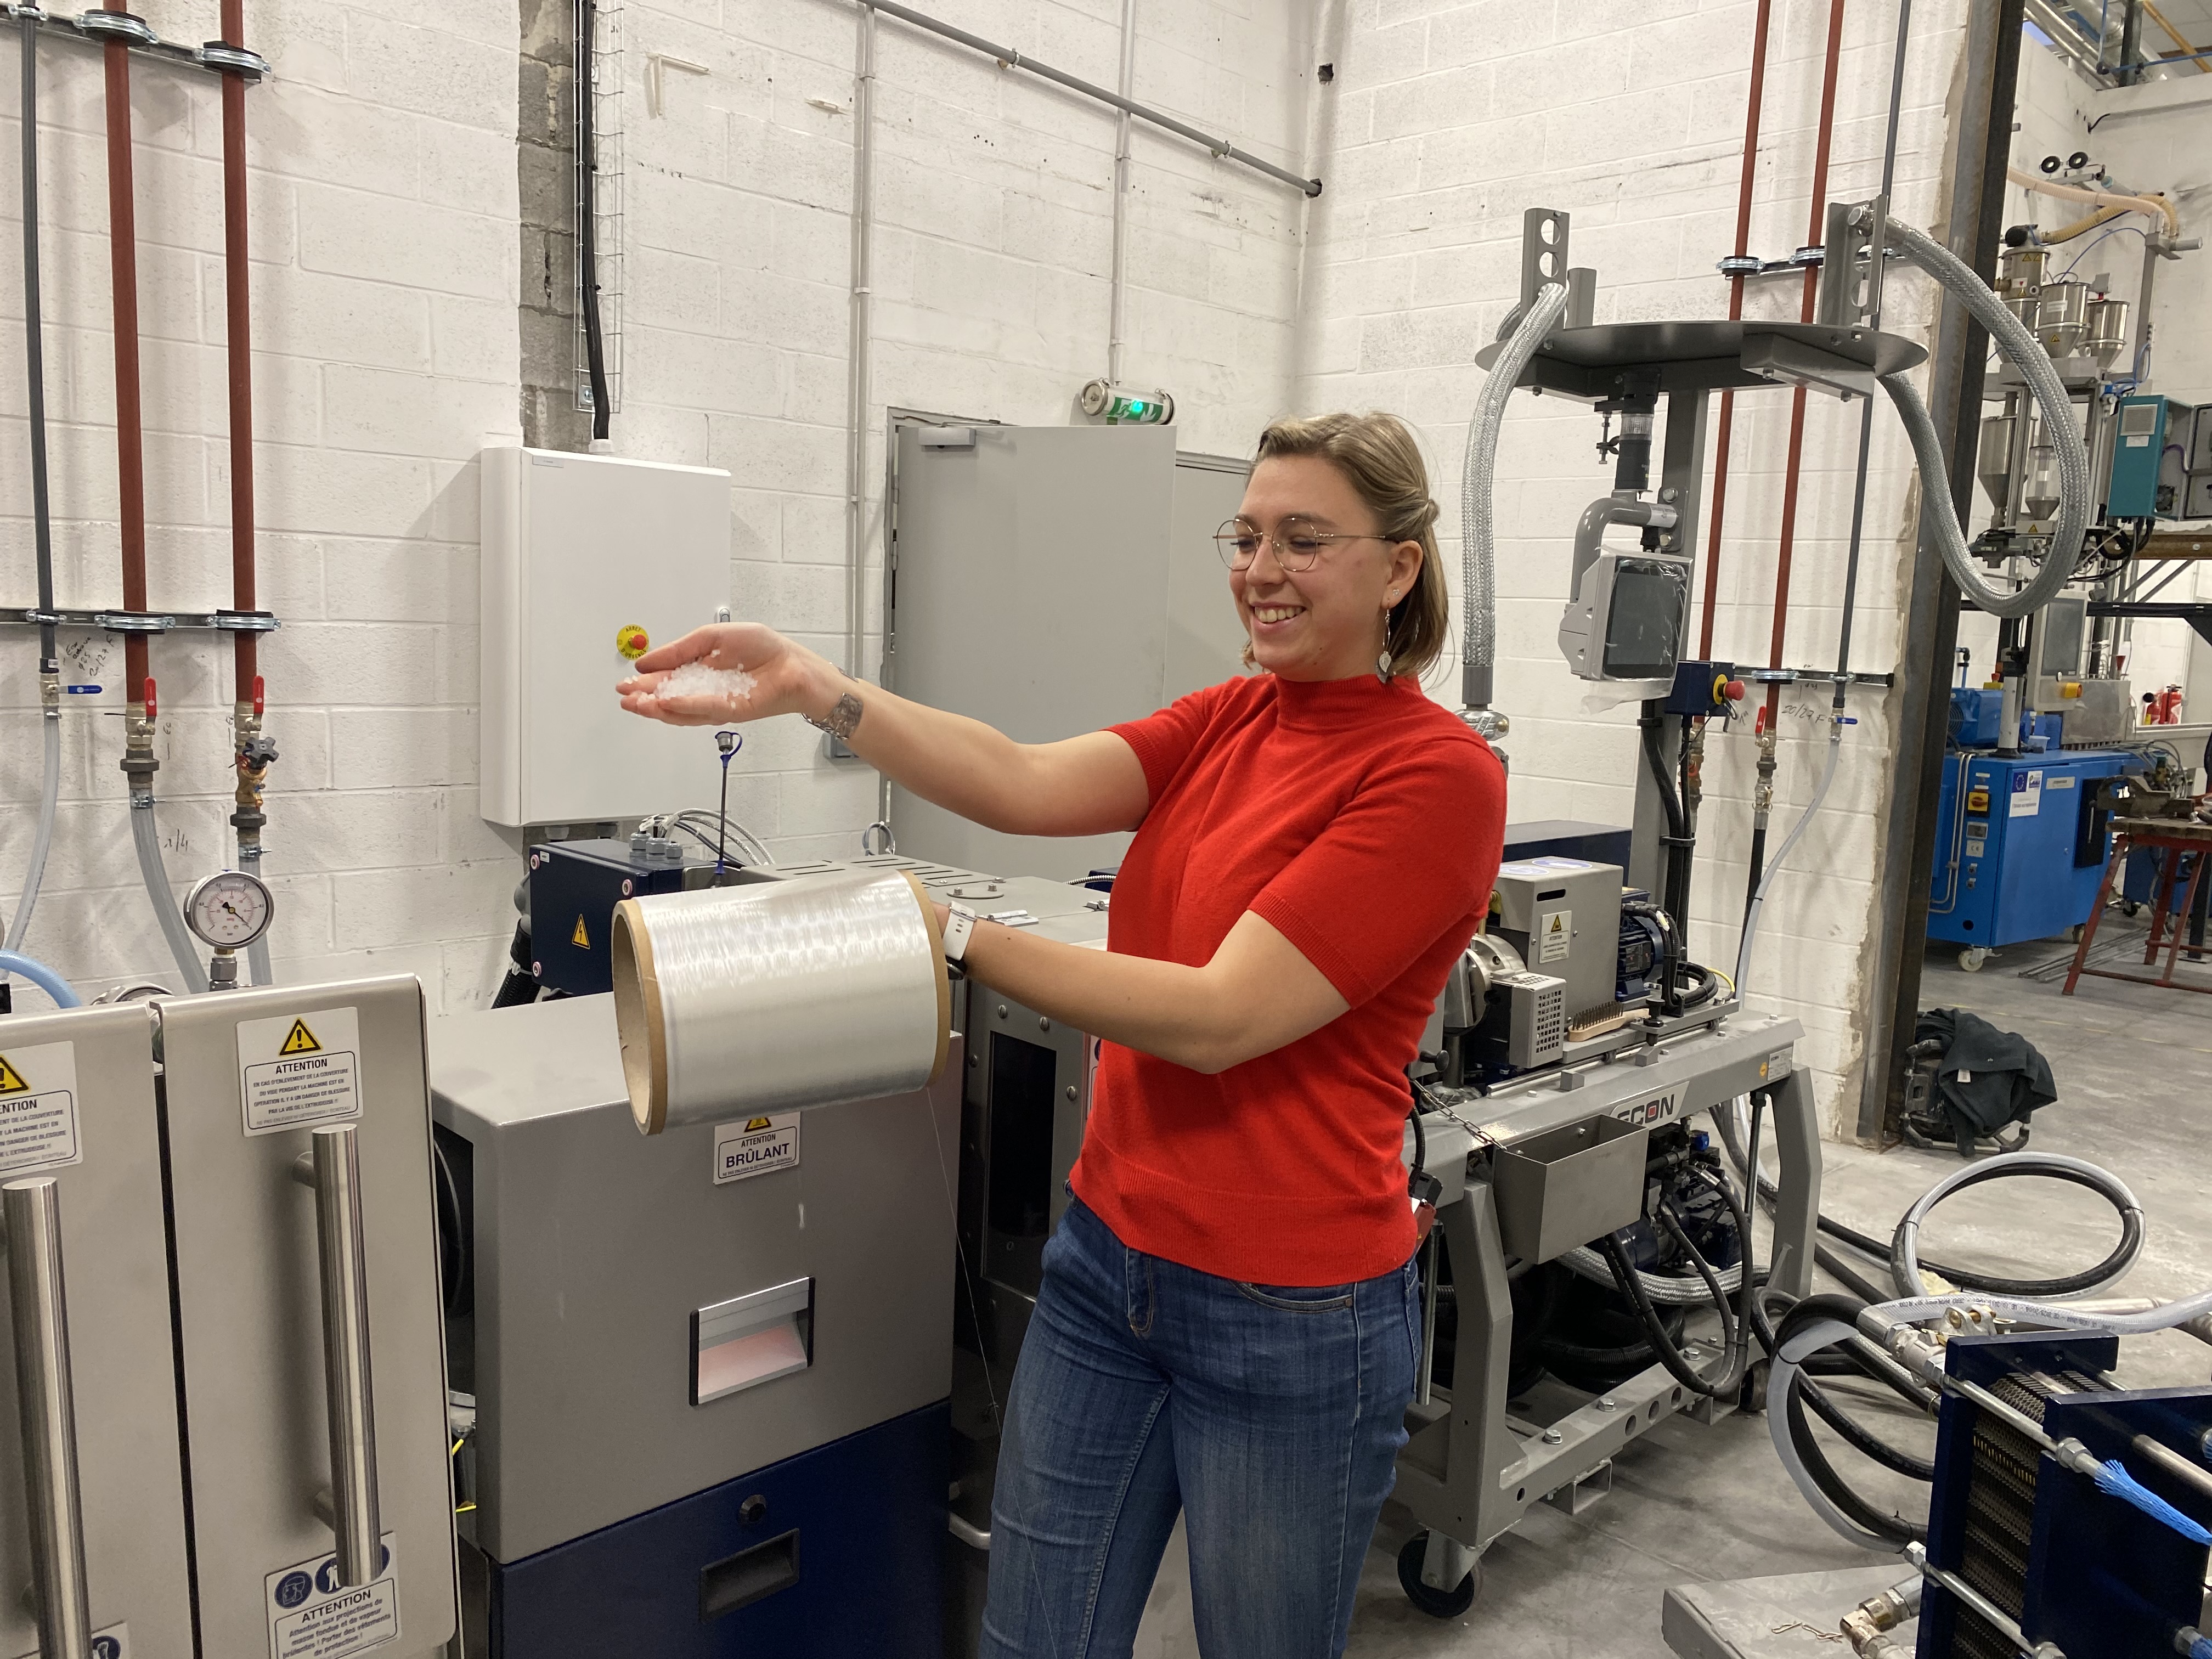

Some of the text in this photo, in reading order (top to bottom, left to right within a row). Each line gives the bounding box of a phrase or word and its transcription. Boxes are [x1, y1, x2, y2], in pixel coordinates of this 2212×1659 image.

[1782, 704, 1814, 721] 20/27
[275, 1058, 328, 1074] ATTENTION
[320, 1068, 348, 1077] COUVERTURE
[253, 1098, 280, 1107] OPERATION
[328, 1087, 350, 1095] BLESSURE
[28, 1109, 64, 1121] COUVERTURE
[13, 1124, 38, 1133] MACHINE
[6, 1136, 29, 1146] DANGER
[38, 1130, 66, 1139] BLESSURE
[741, 1133, 776, 1148] ATTENTION
[726, 1143, 790, 1168] BRÛLANT
[302, 1589, 371, 1623] ATTENTION
[289, 1622, 320, 1638] Attention
[323, 1617, 335, 1625] aux
[336, 1602, 373, 1621] projections
[291, 1634, 314, 1646] masse
[316, 1624, 339, 1637] fondue
[359, 1607, 382, 1621] vapeur
[321, 1632, 342, 1645] Porter
[343, 1627, 356, 1635] des
[357, 1613, 391, 1631] vêtements
[324, 1635, 359, 1654] protection
